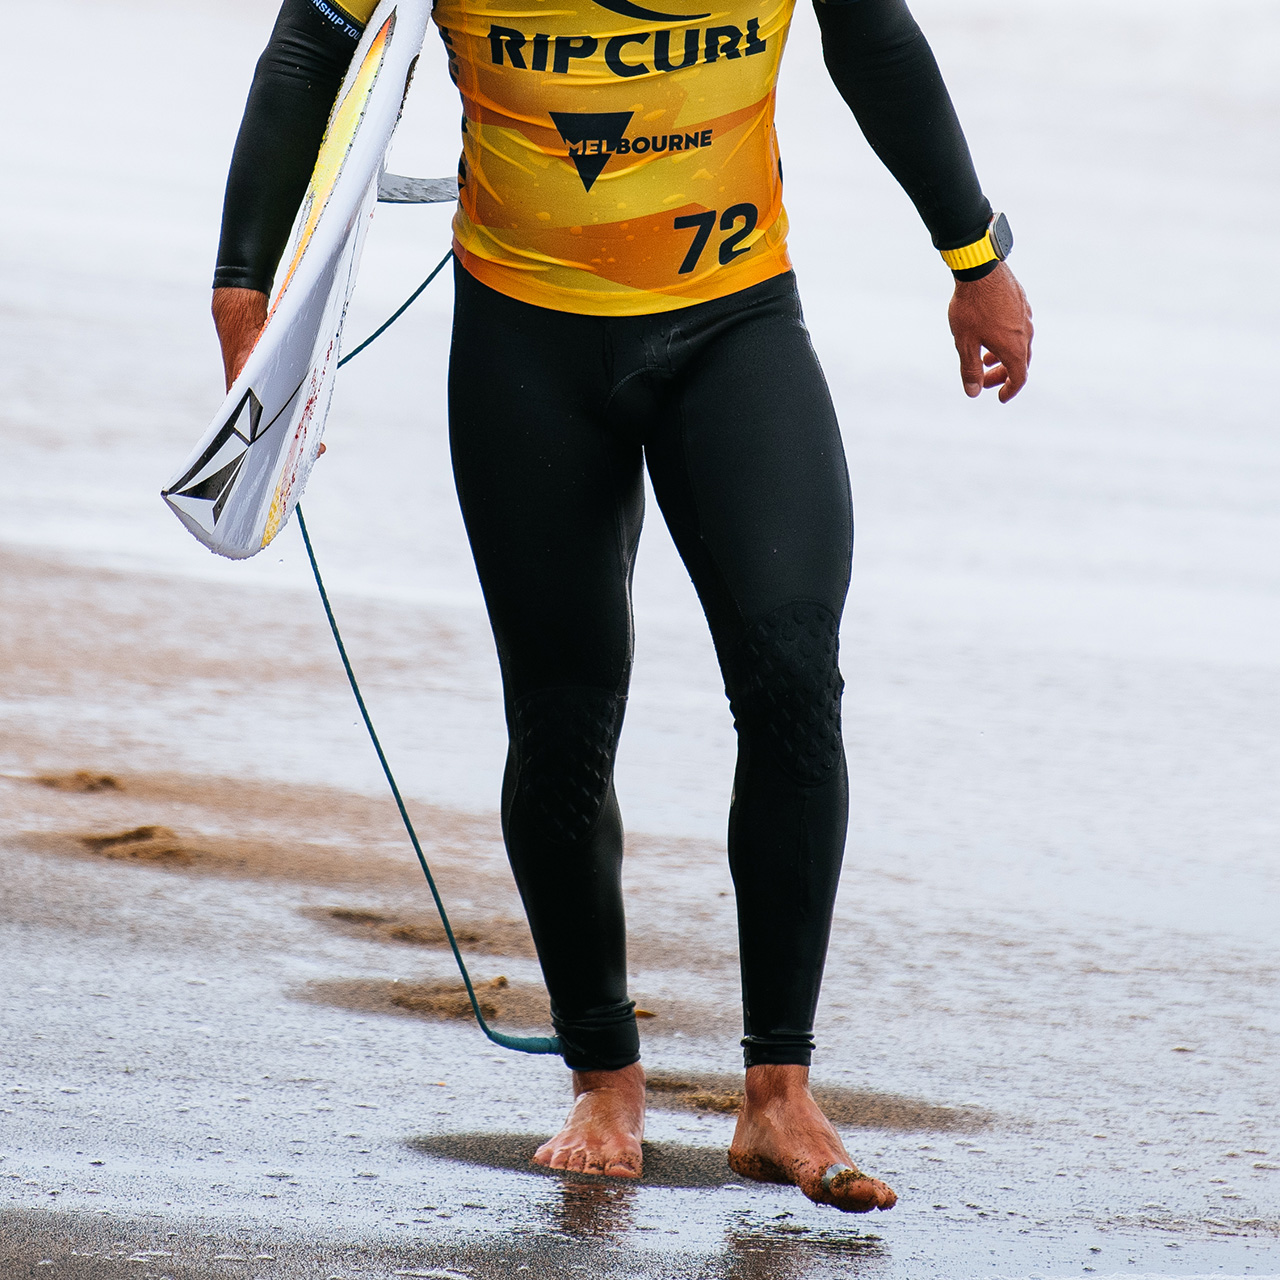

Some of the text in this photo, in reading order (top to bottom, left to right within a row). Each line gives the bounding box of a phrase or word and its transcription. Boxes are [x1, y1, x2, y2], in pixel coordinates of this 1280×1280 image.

[487, 17, 767, 78] RIP CURL
[566, 129, 713, 156] MELBOURNE
[673, 202, 759, 275] 72
